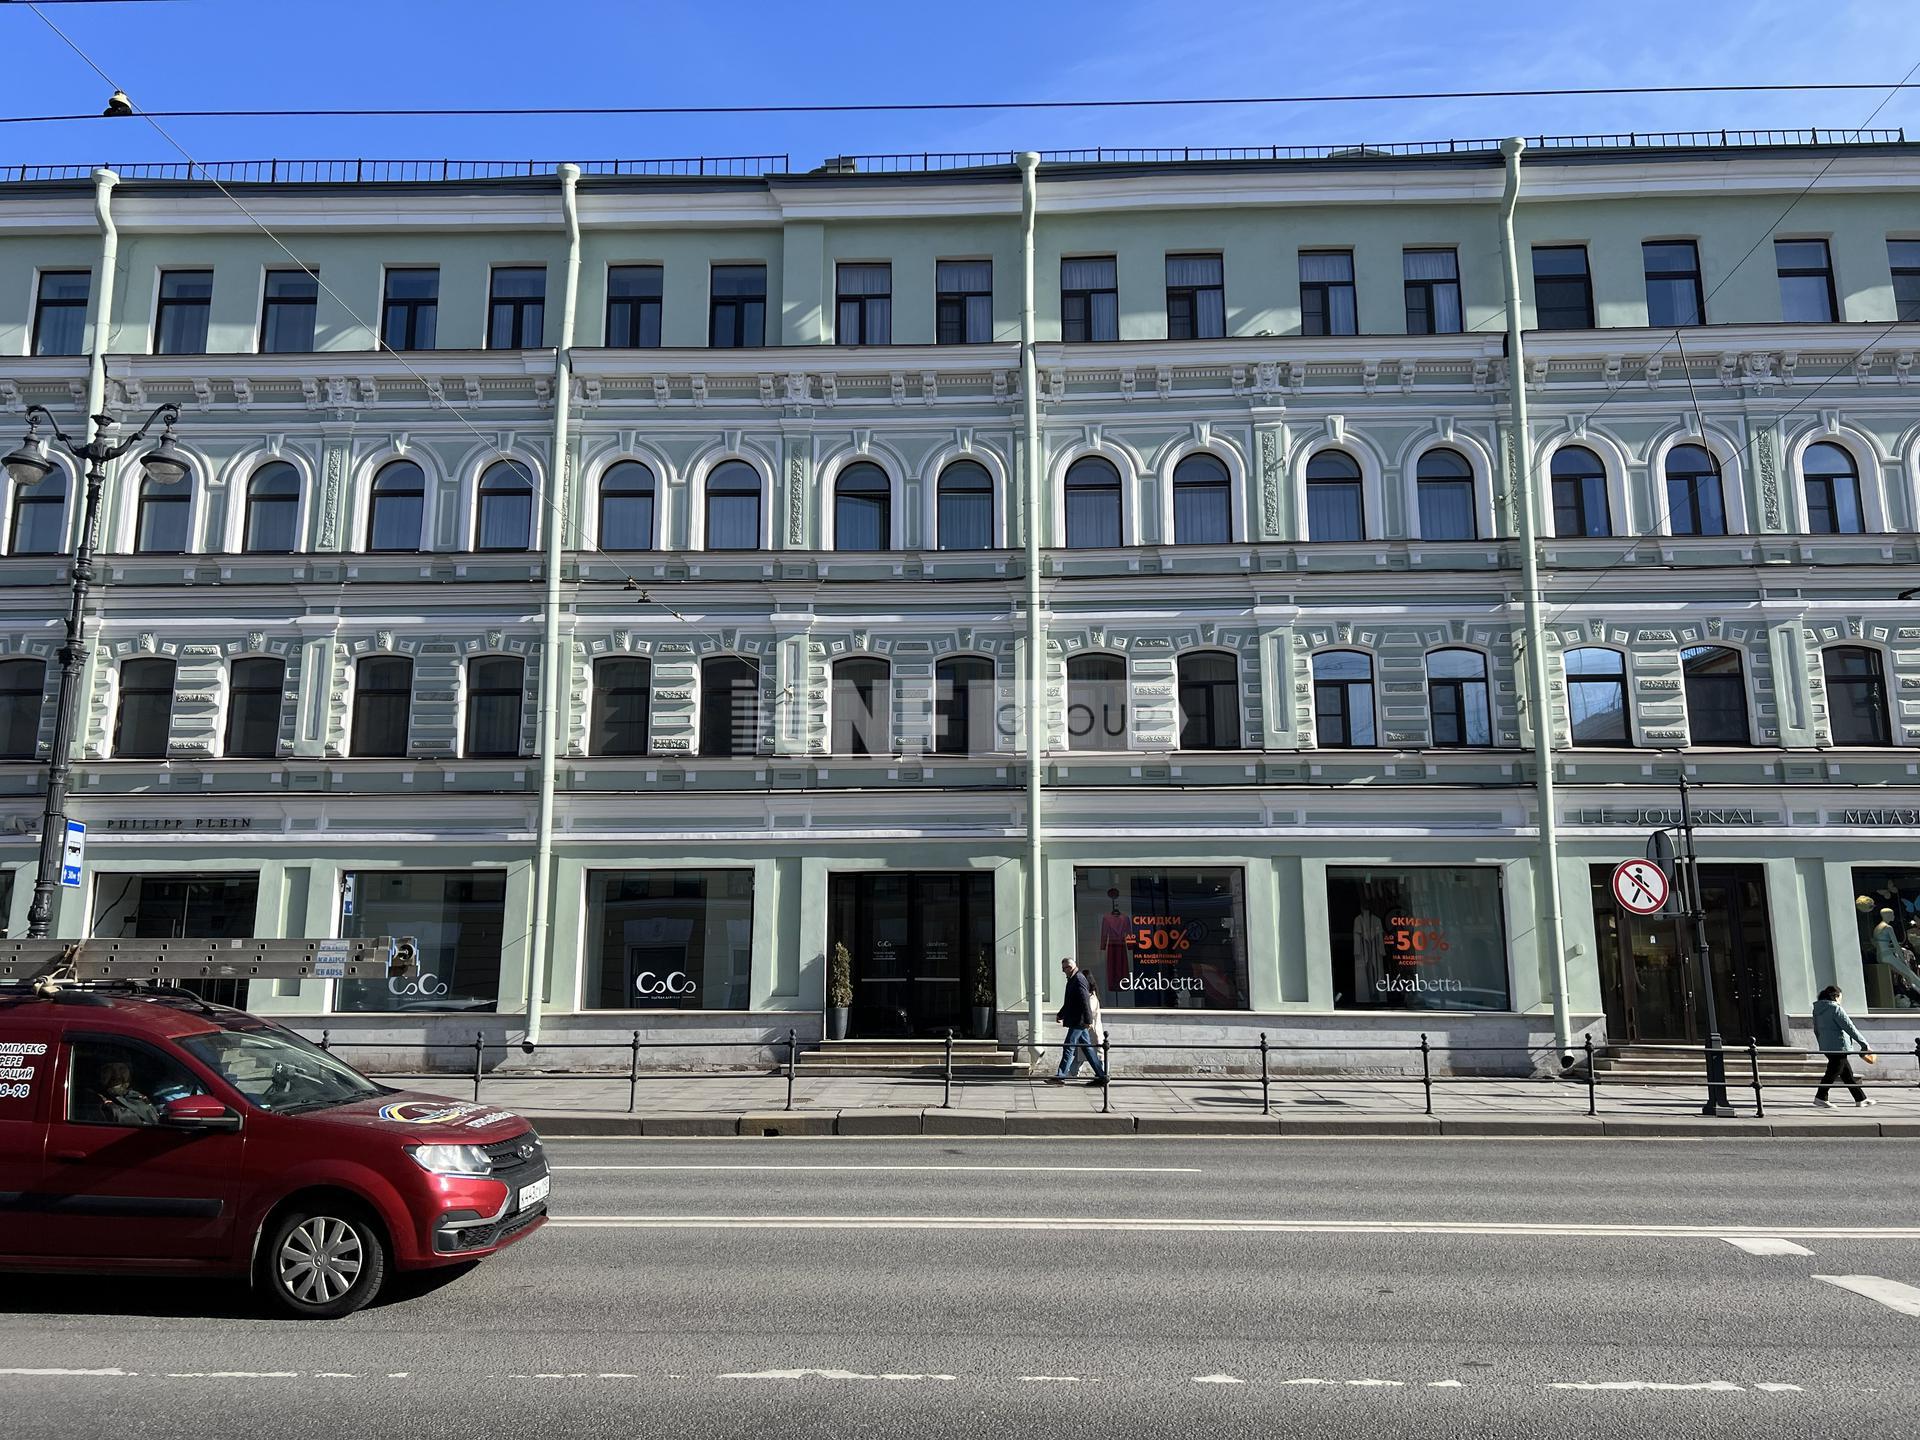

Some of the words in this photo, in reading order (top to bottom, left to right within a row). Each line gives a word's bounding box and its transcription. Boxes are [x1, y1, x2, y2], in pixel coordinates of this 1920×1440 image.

[106, 818, 183, 830] PHILIPP
[195, 817, 251, 829] PLEIN
[1579, 808, 1616, 824] LE
[1626, 808, 1761, 825] JOURNAL
[1133, 915, 1182, 926] СКИДКИ
[635, 971, 697, 994] CoCo
